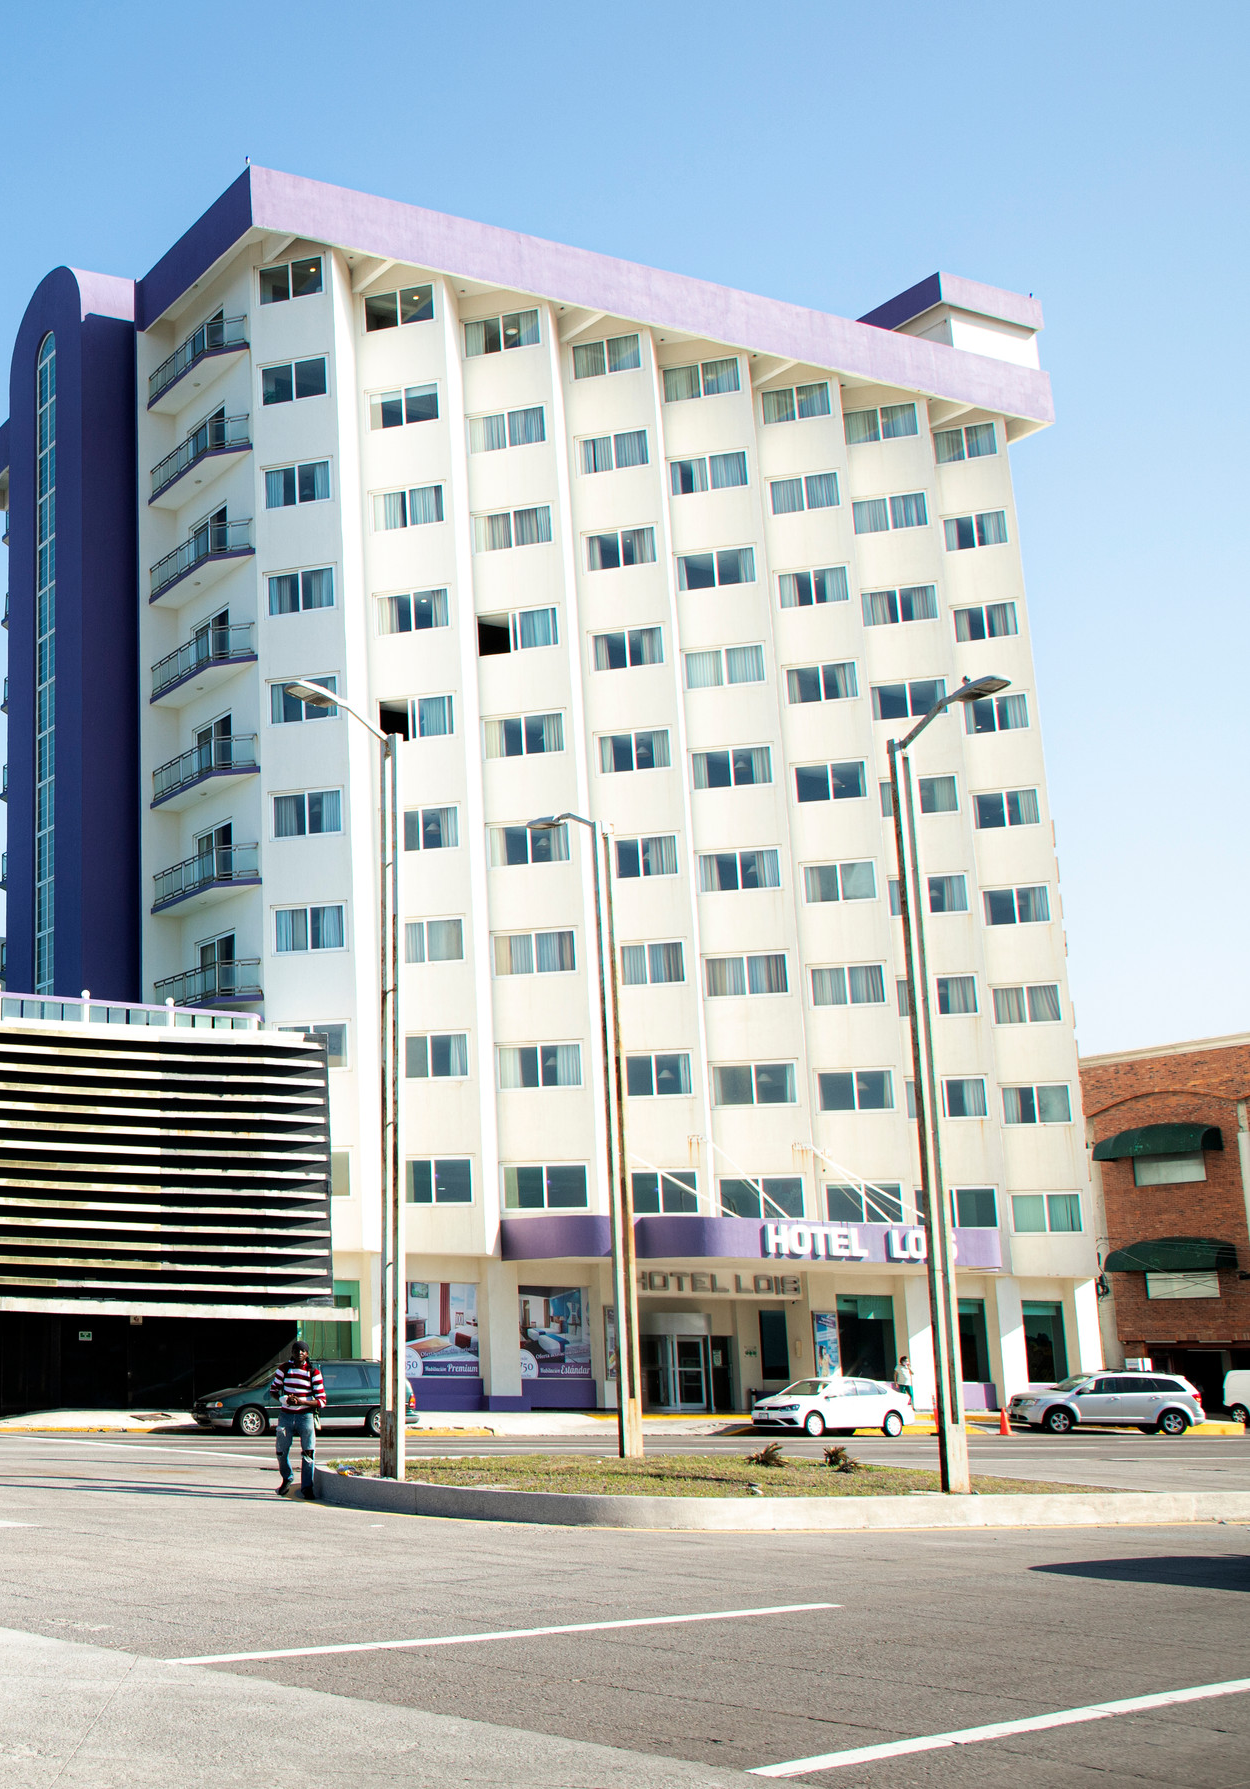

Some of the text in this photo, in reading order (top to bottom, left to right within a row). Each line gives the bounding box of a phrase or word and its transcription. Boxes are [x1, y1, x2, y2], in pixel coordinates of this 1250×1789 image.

[764, 1223, 958, 1260] HOTEL LO
[406, 1360, 418, 1371] 50
[446, 1363, 479, 1373] Premium
[560, 1364, 591, 1375] Estándar
